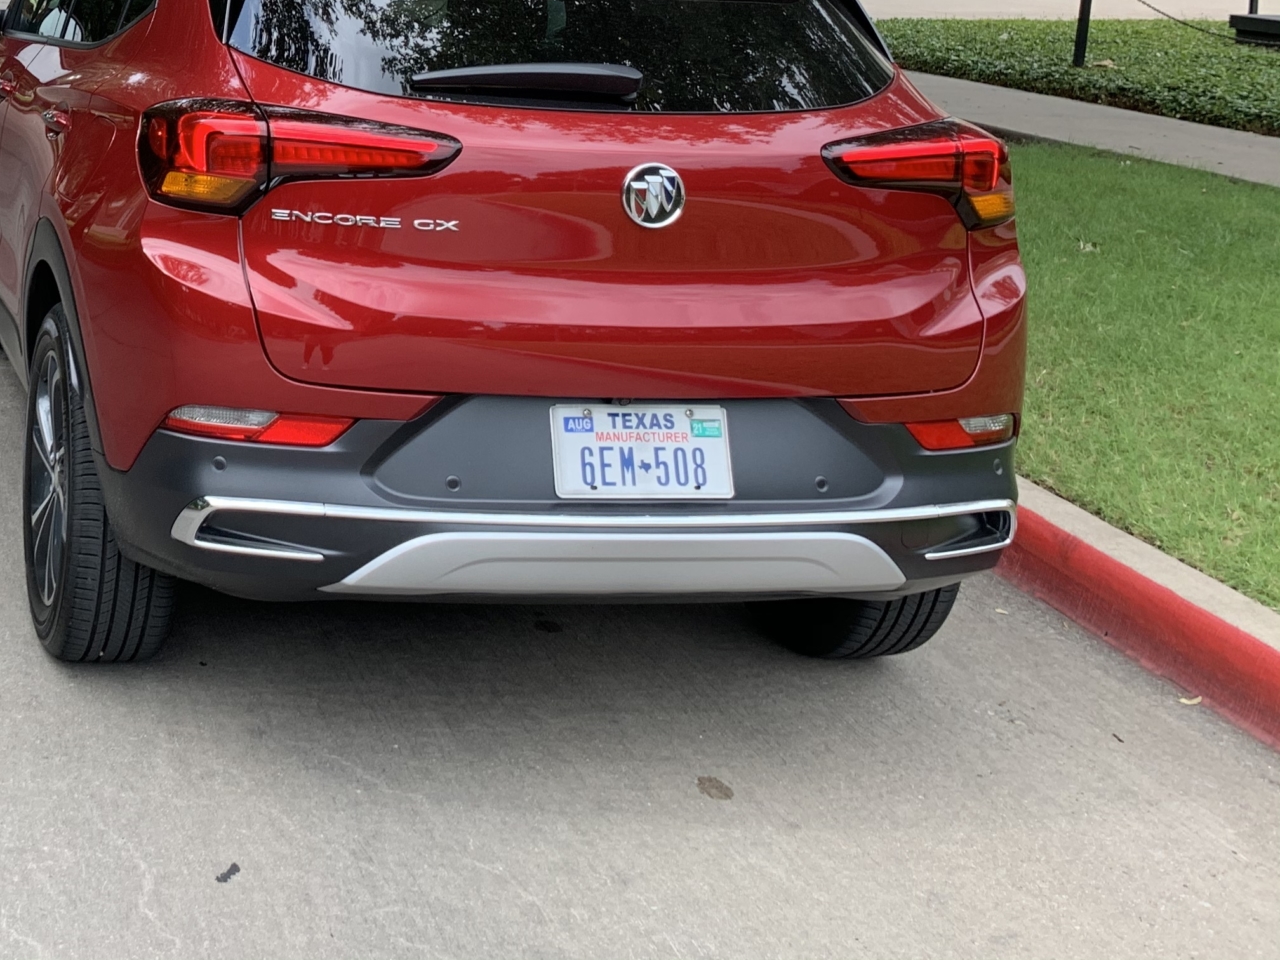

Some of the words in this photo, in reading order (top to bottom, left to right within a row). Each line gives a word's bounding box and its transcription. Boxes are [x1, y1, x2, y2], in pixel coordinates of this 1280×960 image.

[271, 209, 401, 228] ENCORE
[413, 219, 459, 231] GX
[568, 418, 591, 430] AUG
[607, 412, 675, 430] TEXAS
[693, 422, 702, 434] 21
[595, 431, 689, 443] MANUFACTURER
